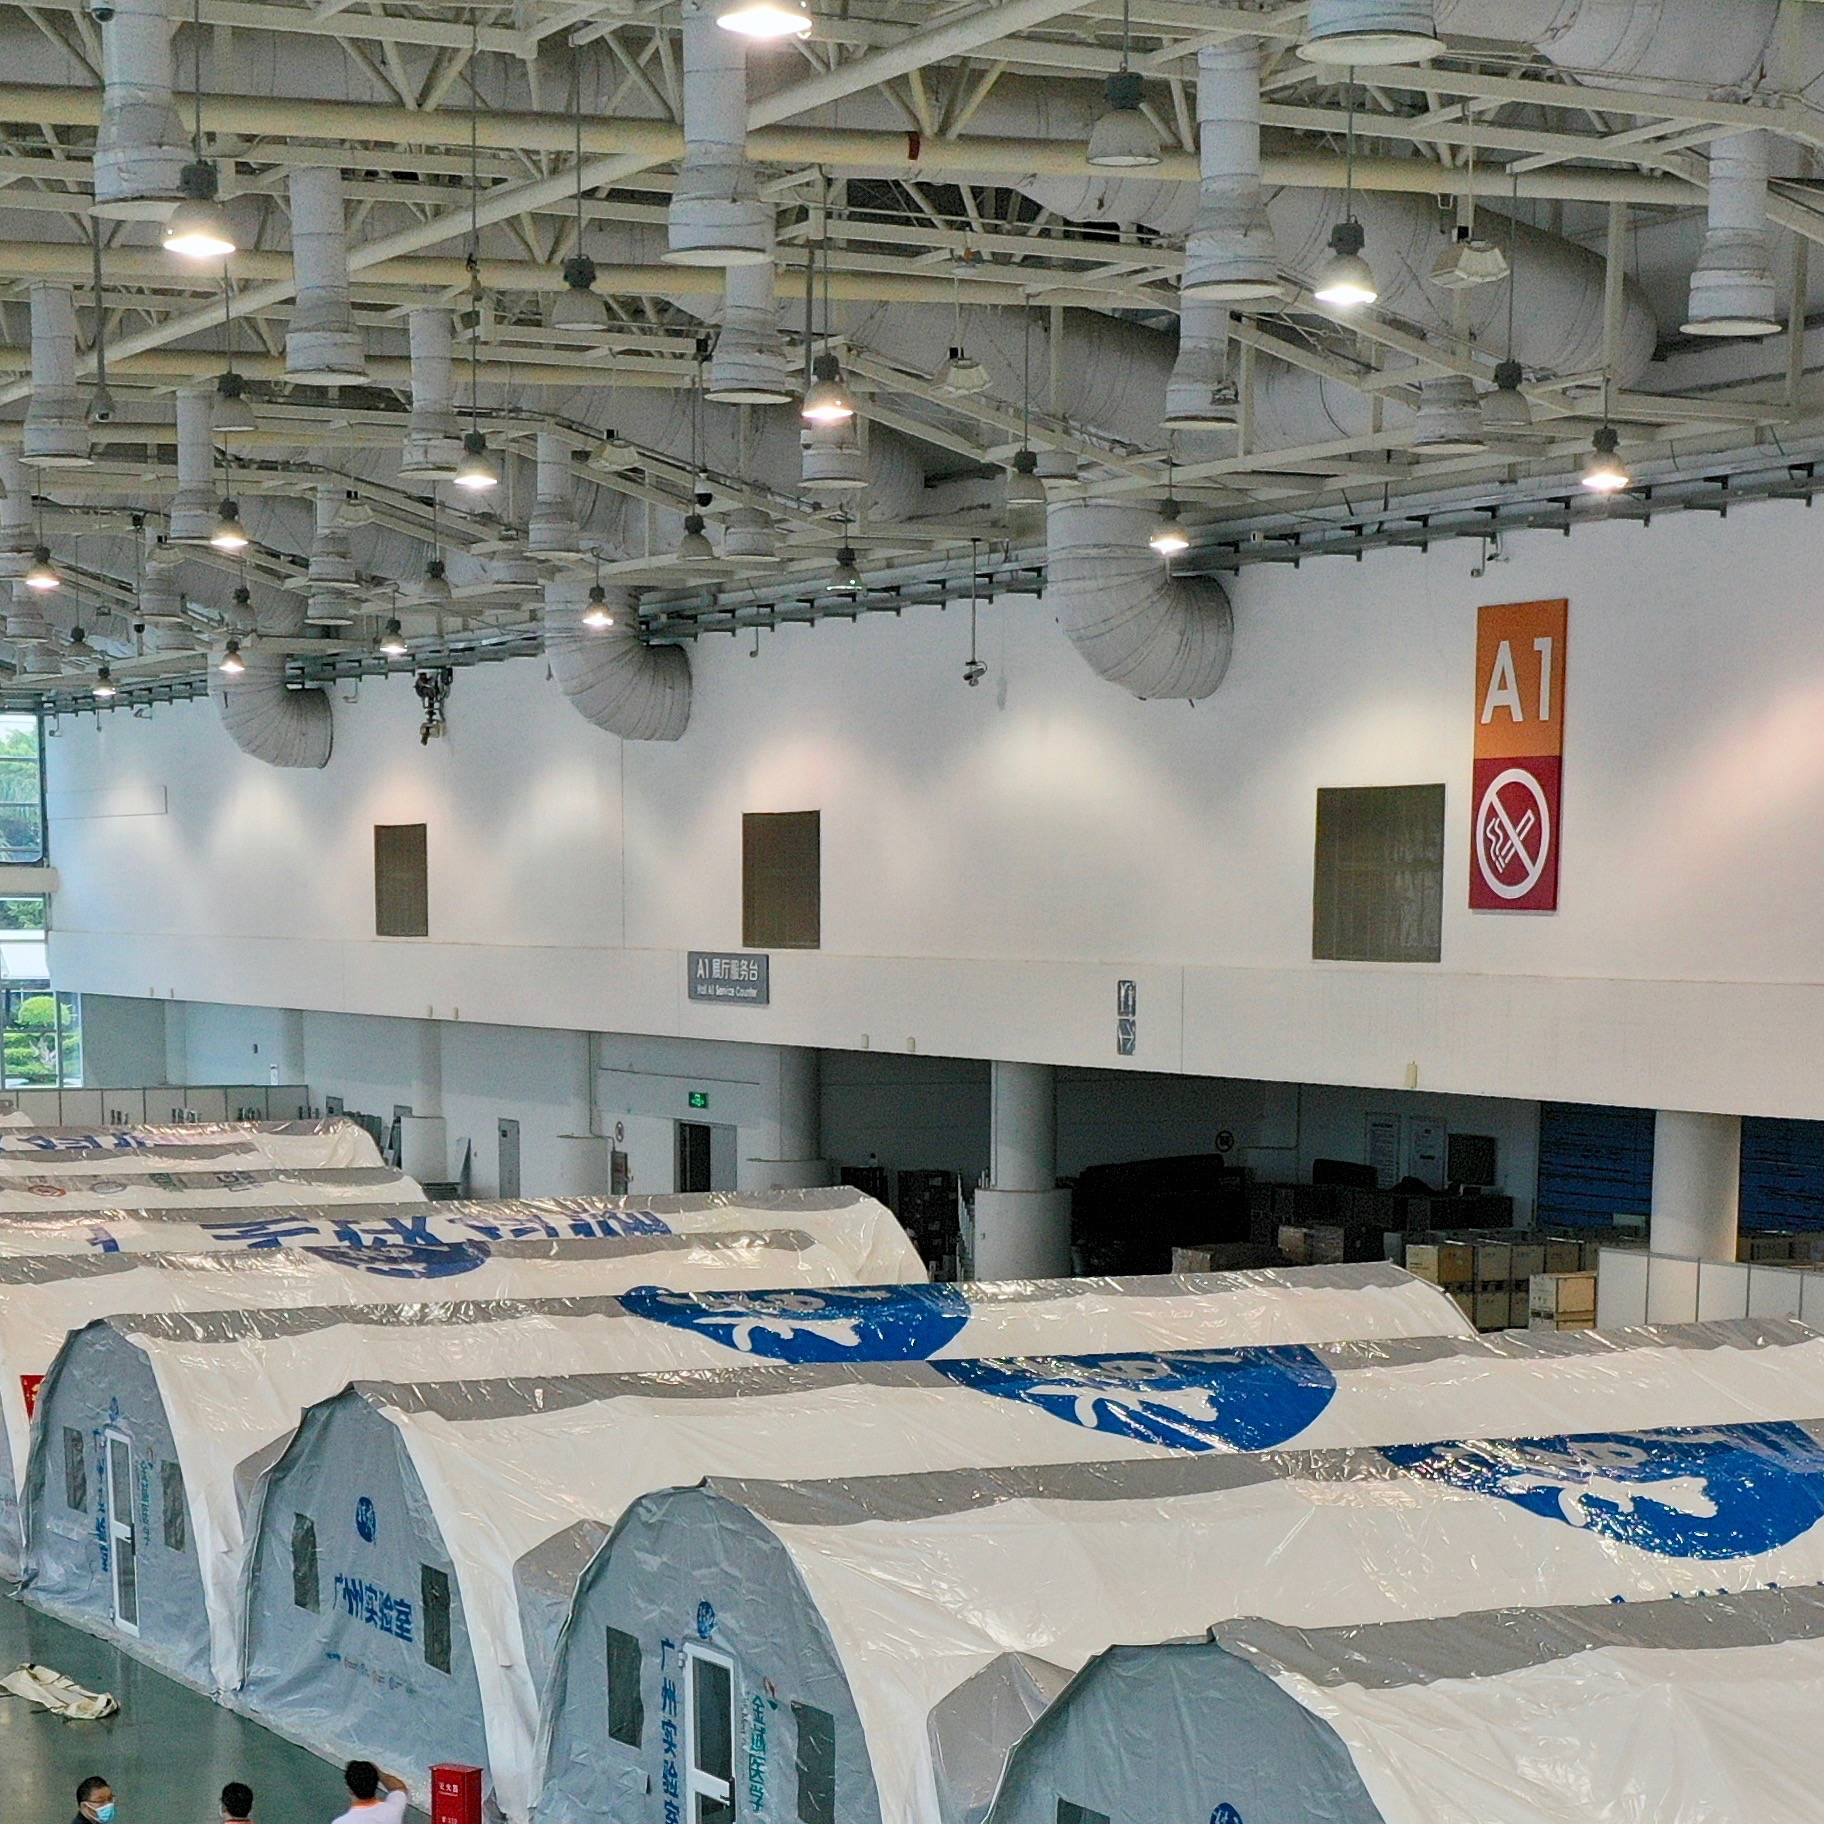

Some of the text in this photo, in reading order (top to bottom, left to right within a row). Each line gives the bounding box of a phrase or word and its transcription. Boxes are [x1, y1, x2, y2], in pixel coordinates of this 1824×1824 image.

[1480, 635, 1553, 725] A1
[696, 958, 759, 982] A1 展厅服务台
[333, 1573, 414, 1644] 广州实验室
